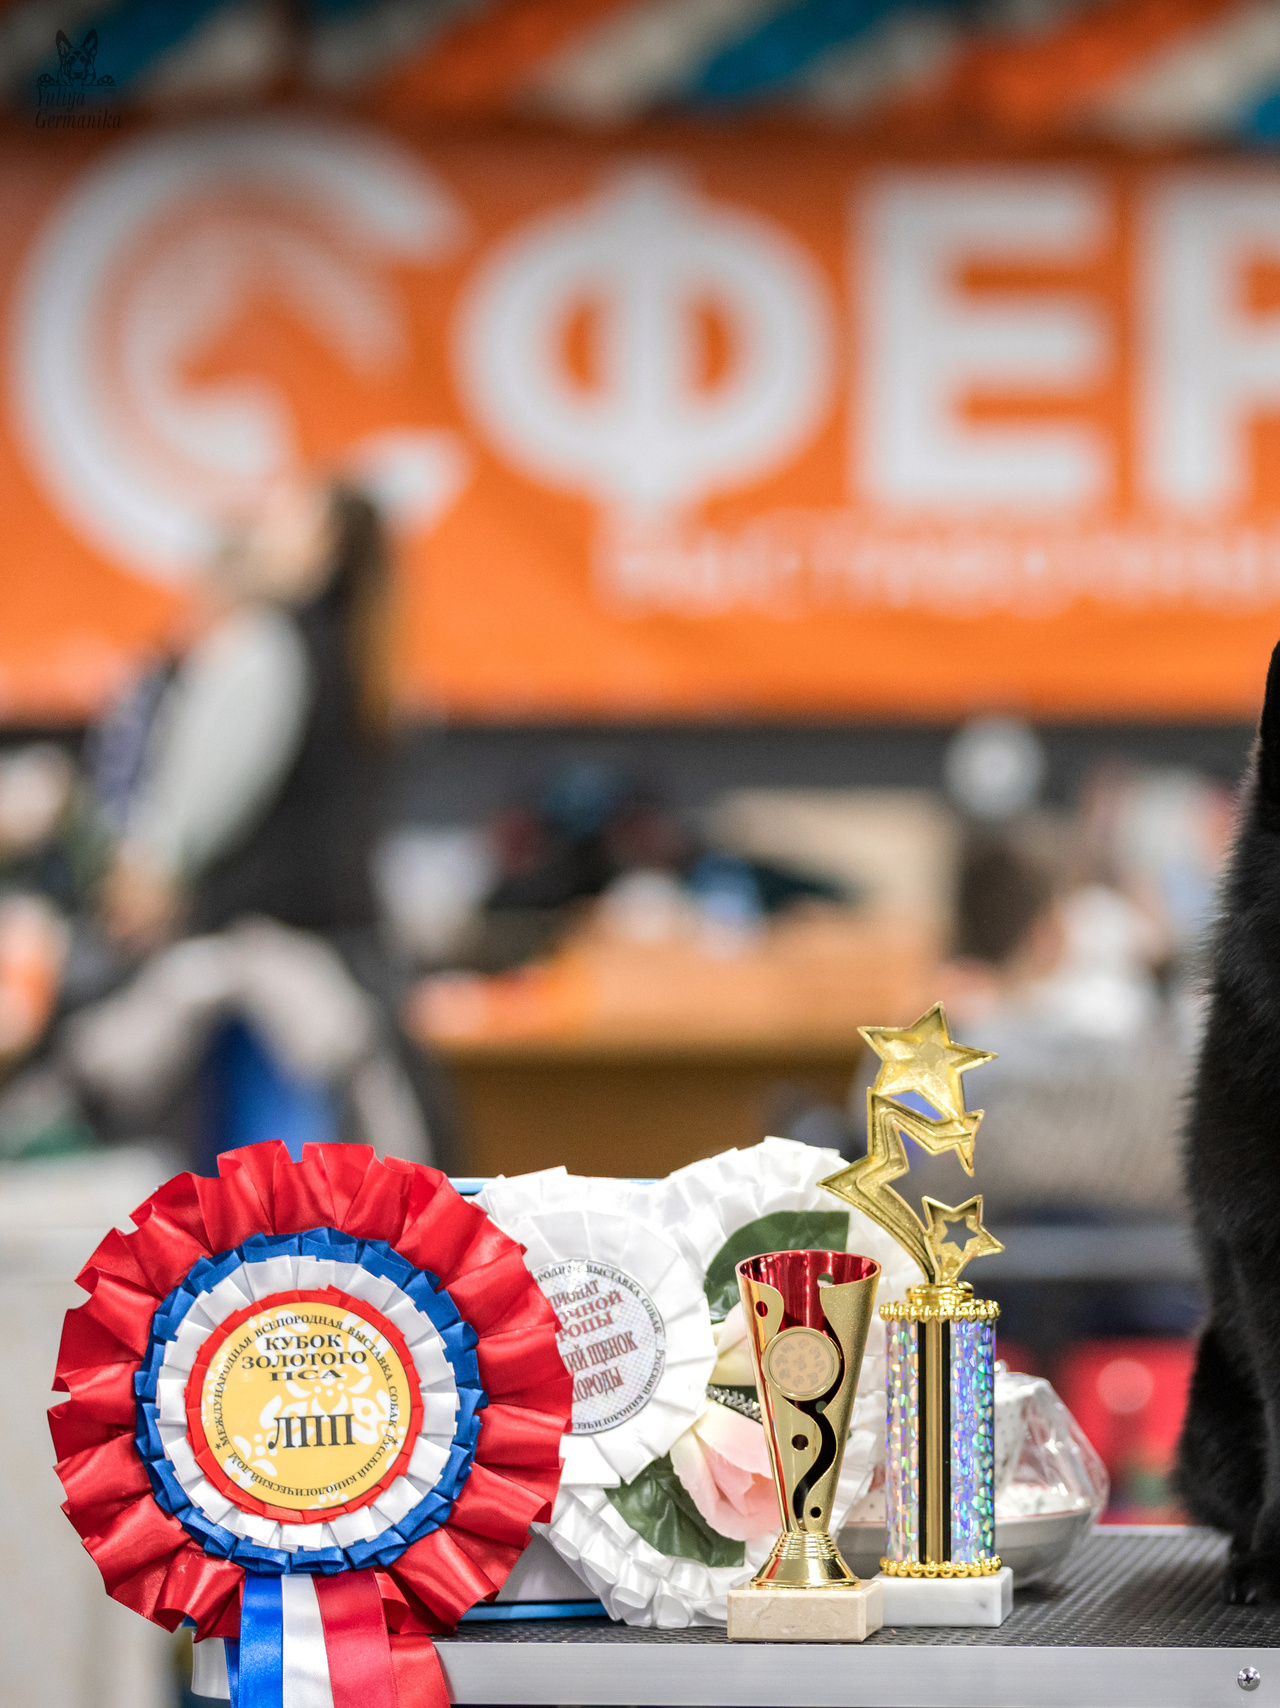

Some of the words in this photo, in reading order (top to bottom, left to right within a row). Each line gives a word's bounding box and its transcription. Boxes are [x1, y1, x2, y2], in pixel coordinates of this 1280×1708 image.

[547, 1280, 600, 1309] ПИОНАТ
[557, 1289, 624, 1324] ОЧНОЙ
[557, 1311, 614, 1342] РОПЫ
[641, 1297, 662, 1335] СОБАК
[264, 1333, 342, 1351] КУБОК
[585, 1330, 639, 1366] ЩЕНОК
[241, 1350, 368, 1370] ЗОЛОТОГО
[269, 1369, 345, 1382] ПСА
[213, 1336, 253, 1447] МЕЖДУНАРОДНАЯ
[254, 1314, 344, 1338] ВСЕПОРОДНАЯ
[347, 1325, 394, 1382] ВЫСТАВКА
[387, 1385, 399, 1429] СОБАК
[572, 1394, 645, 1431] КИНОЛОГИЧЕС
[267, 1413, 357, 1450] ЛПП
[227, 1450, 251, 1475] ДОМ
[249, 1472, 358, 1497] КИНОЛОГИЧЕСКИЙ
